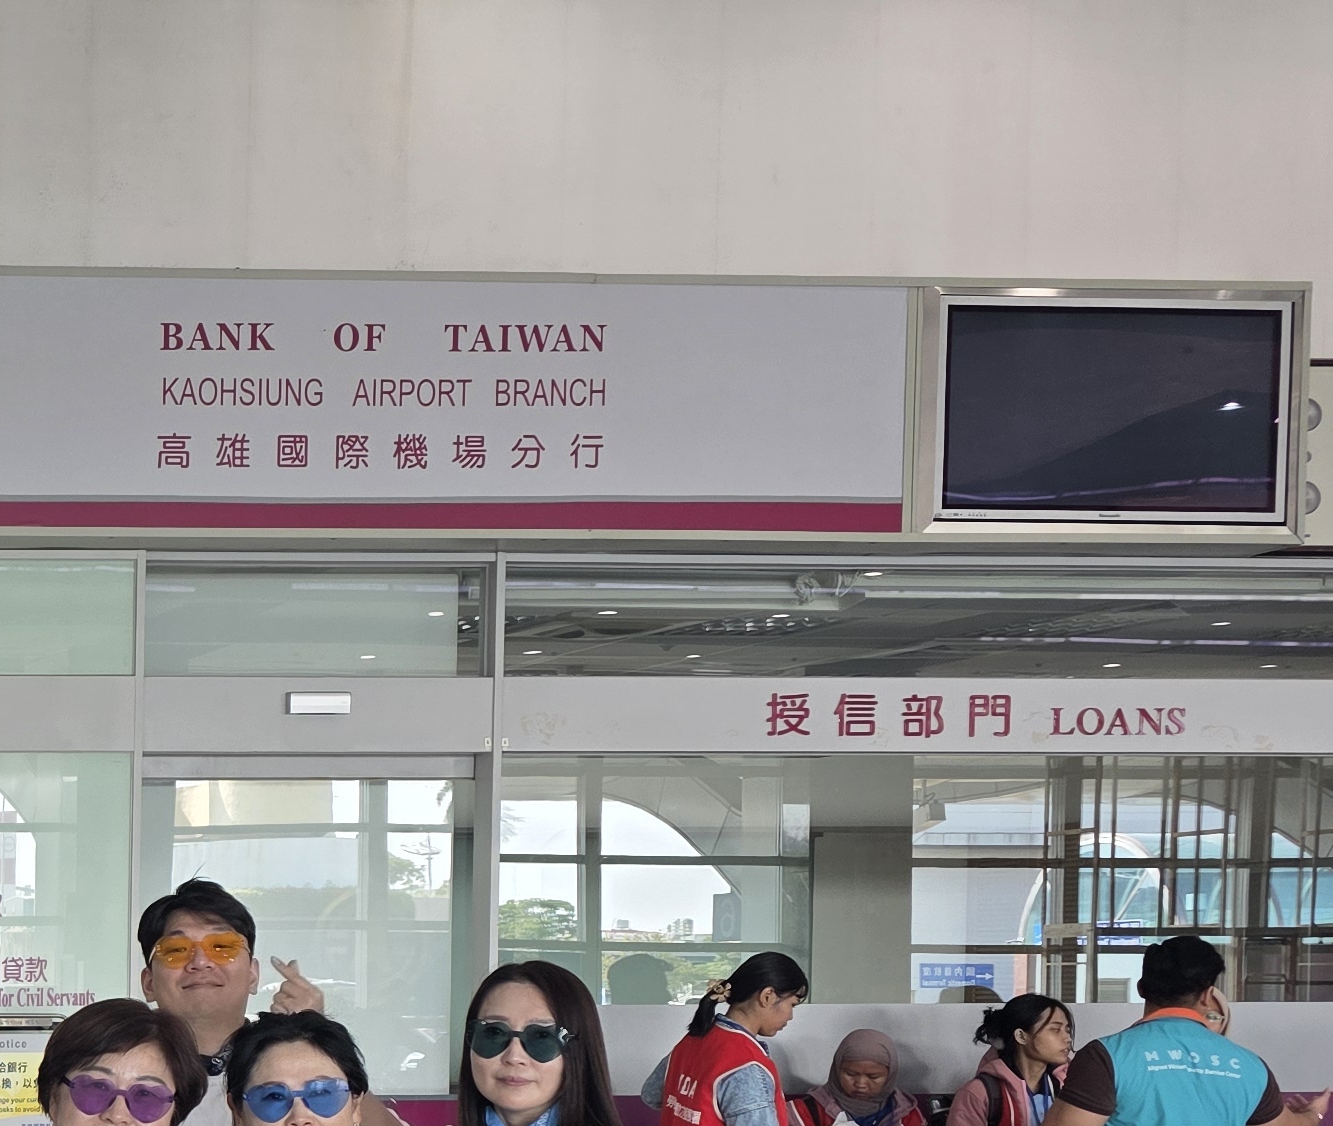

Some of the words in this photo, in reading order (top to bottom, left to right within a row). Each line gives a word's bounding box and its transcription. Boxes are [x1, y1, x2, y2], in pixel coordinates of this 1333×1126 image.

[159, 322, 275, 352] BANK
[333, 323, 387, 353] OF
[444, 324, 608, 354] TAIWAN
[161, 377, 325, 407] KAOHSIUNG
[352, 378, 473, 408] AIRPORT
[494, 378, 607, 408] BRANCH
[156, 432, 605, 470] 高雄國際機場分行
[766, 692, 1012, 739] 授信部門
[1049, 707, 1187, 737] LOANS
[16, 987, 44, 1007] Civil
[46, 986, 96, 1006] Servants
